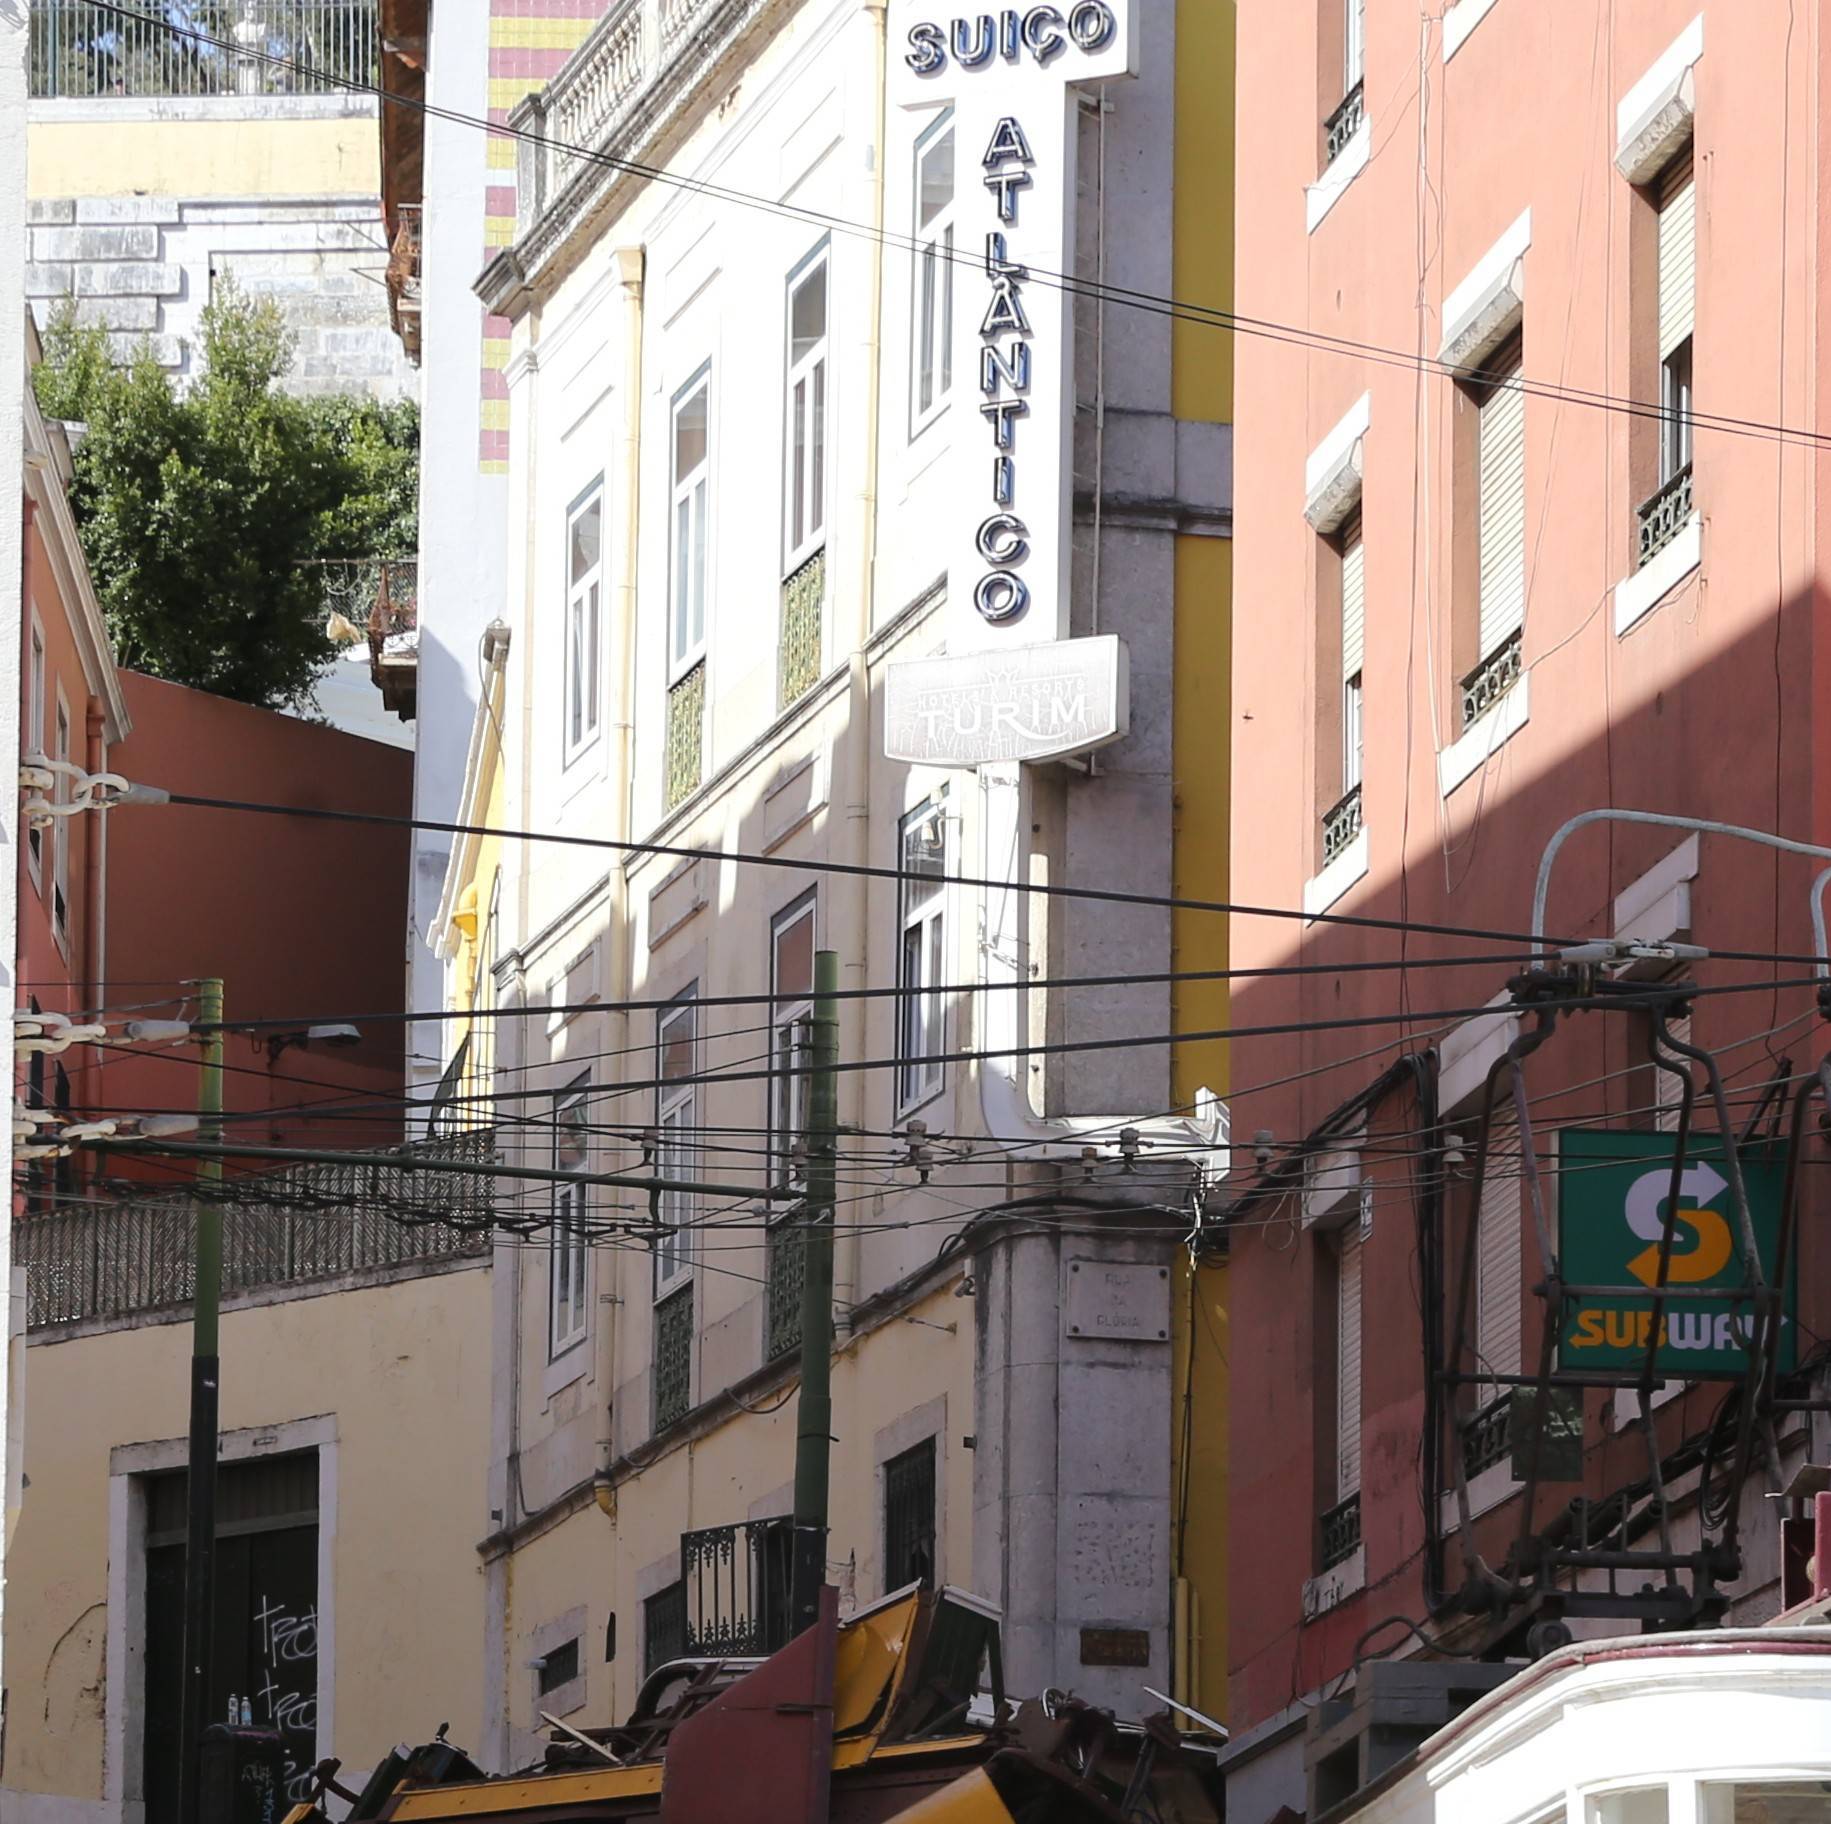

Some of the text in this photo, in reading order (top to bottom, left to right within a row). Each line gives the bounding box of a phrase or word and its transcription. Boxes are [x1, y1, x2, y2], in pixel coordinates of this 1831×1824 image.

[905, 0, 1118, 77] SUIÇO
[917, 693, 1086, 741] TURIM
[1568, 1308, 1789, 1351] SUBWA
